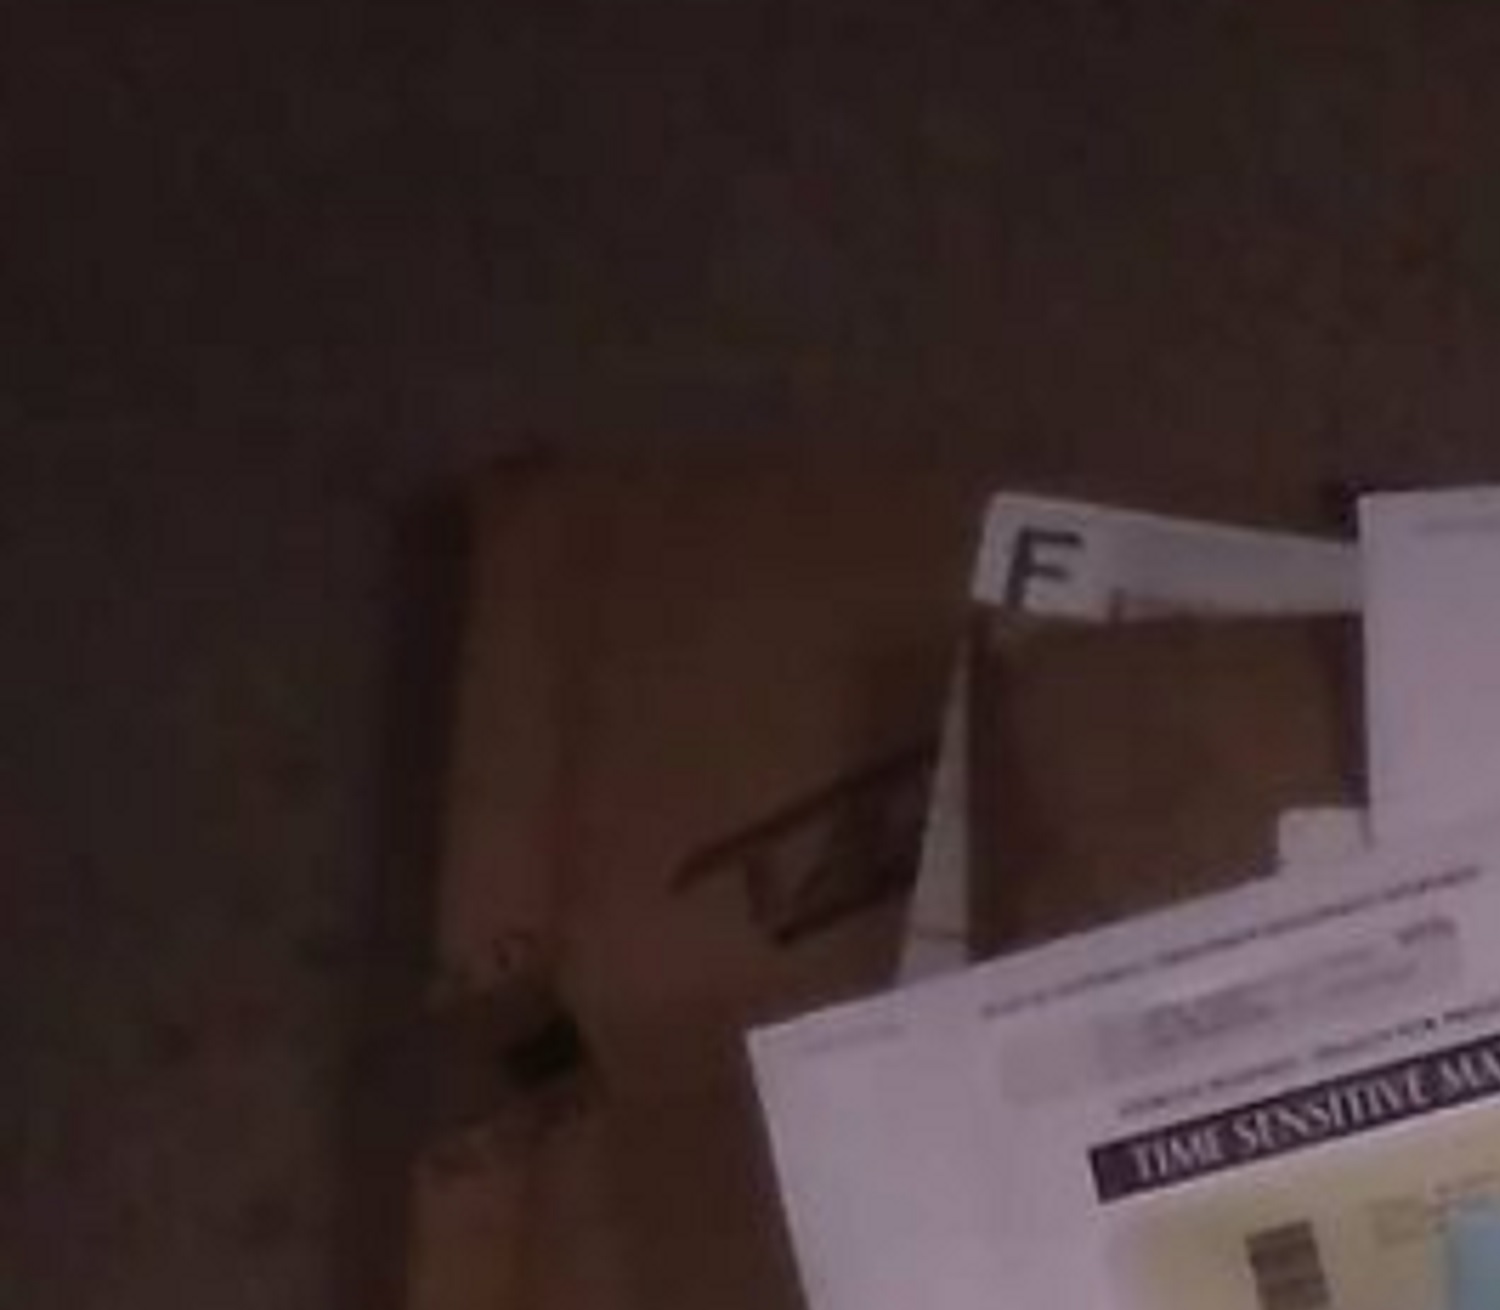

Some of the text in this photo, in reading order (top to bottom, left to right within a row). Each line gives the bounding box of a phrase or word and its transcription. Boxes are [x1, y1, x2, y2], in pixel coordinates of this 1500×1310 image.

[1001, 522, 1084, 620] F
[1129, 1122, 1226, 1182] TIME
[1231, 1063, 1432, 1157] SENSITIVE
